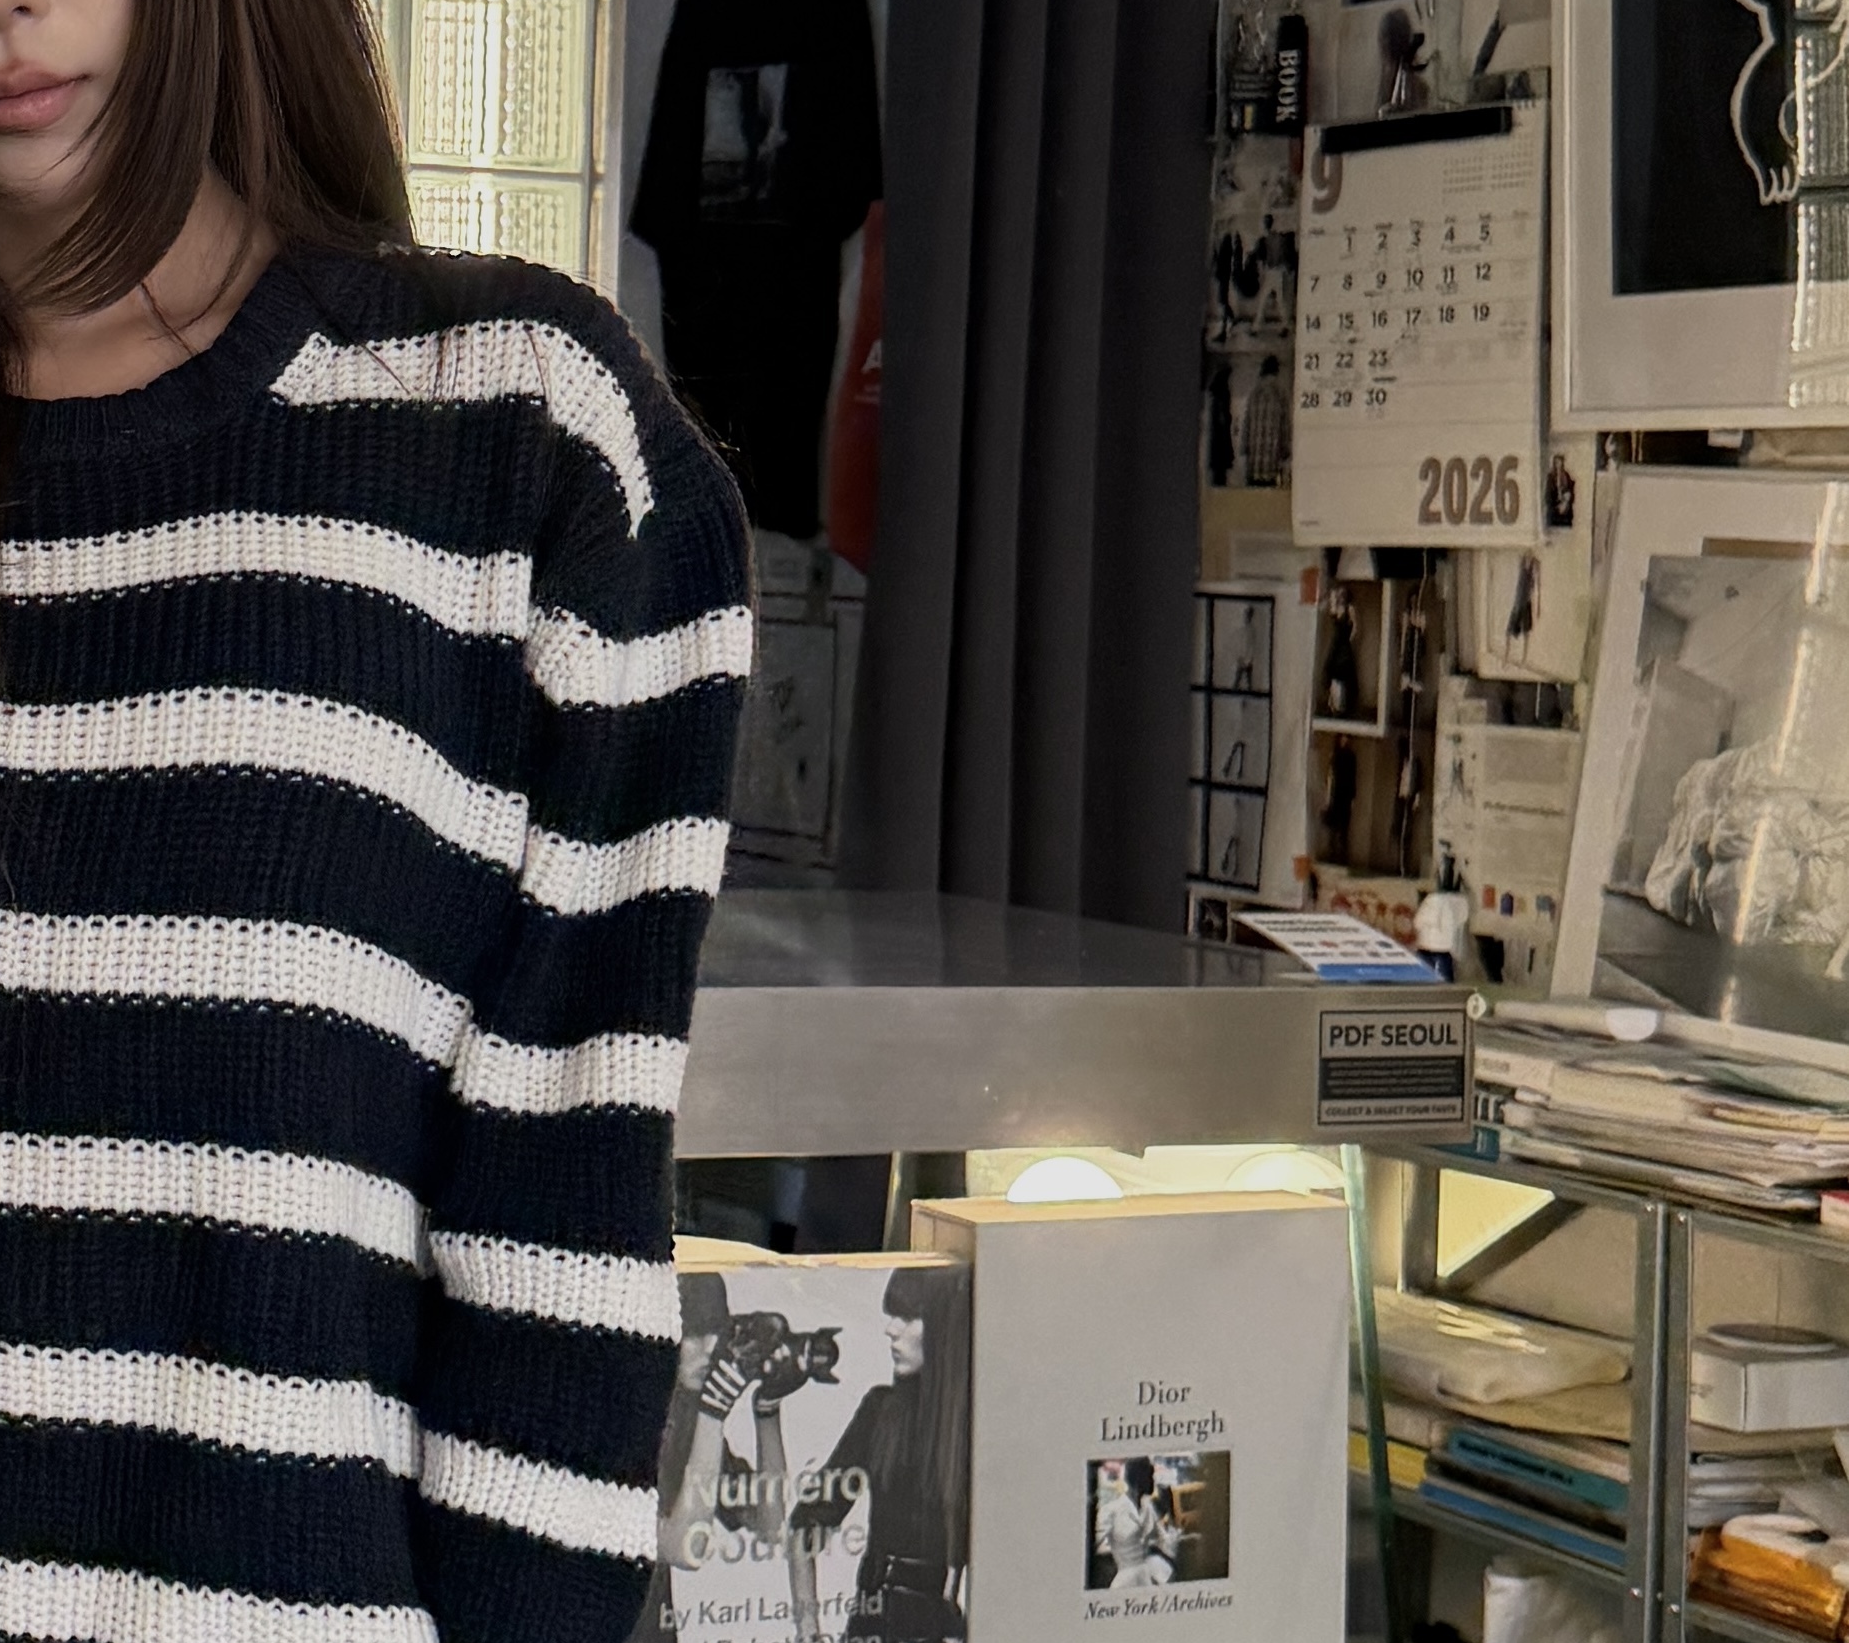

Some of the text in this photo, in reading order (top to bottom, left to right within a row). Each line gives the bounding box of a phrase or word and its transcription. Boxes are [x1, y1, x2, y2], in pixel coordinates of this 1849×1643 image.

[1275, 48, 1299, 124] BOOK
[1378, 233, 1388, 250] 2
[1445, 225, 1455, 242] 4
[1480, 224, 1490, 242] 5
[1310, 263, 1492, 292] 7 8 9 10 11 12
[1305, 304, 1490, 331] 14 15 16 17 18 19
[1304, 349, 1388, 370] 21 22 23
[1301, 388, 1387, 408] 28 29 30
[1417, 455, 1520, 526] 2026
[1329, 1023, 1458, 1047] PDF SEOUL
[1138, 1380, 1191, 1405] Dior
[1101, 1410, 1225, 1442] Lindbergh
[684, 1457, 869, 1508] Numéro
[659, 1589, 883, 1631] by Karl Larfeld
[1084, 1592, 1233, 1621] New York/Archives
